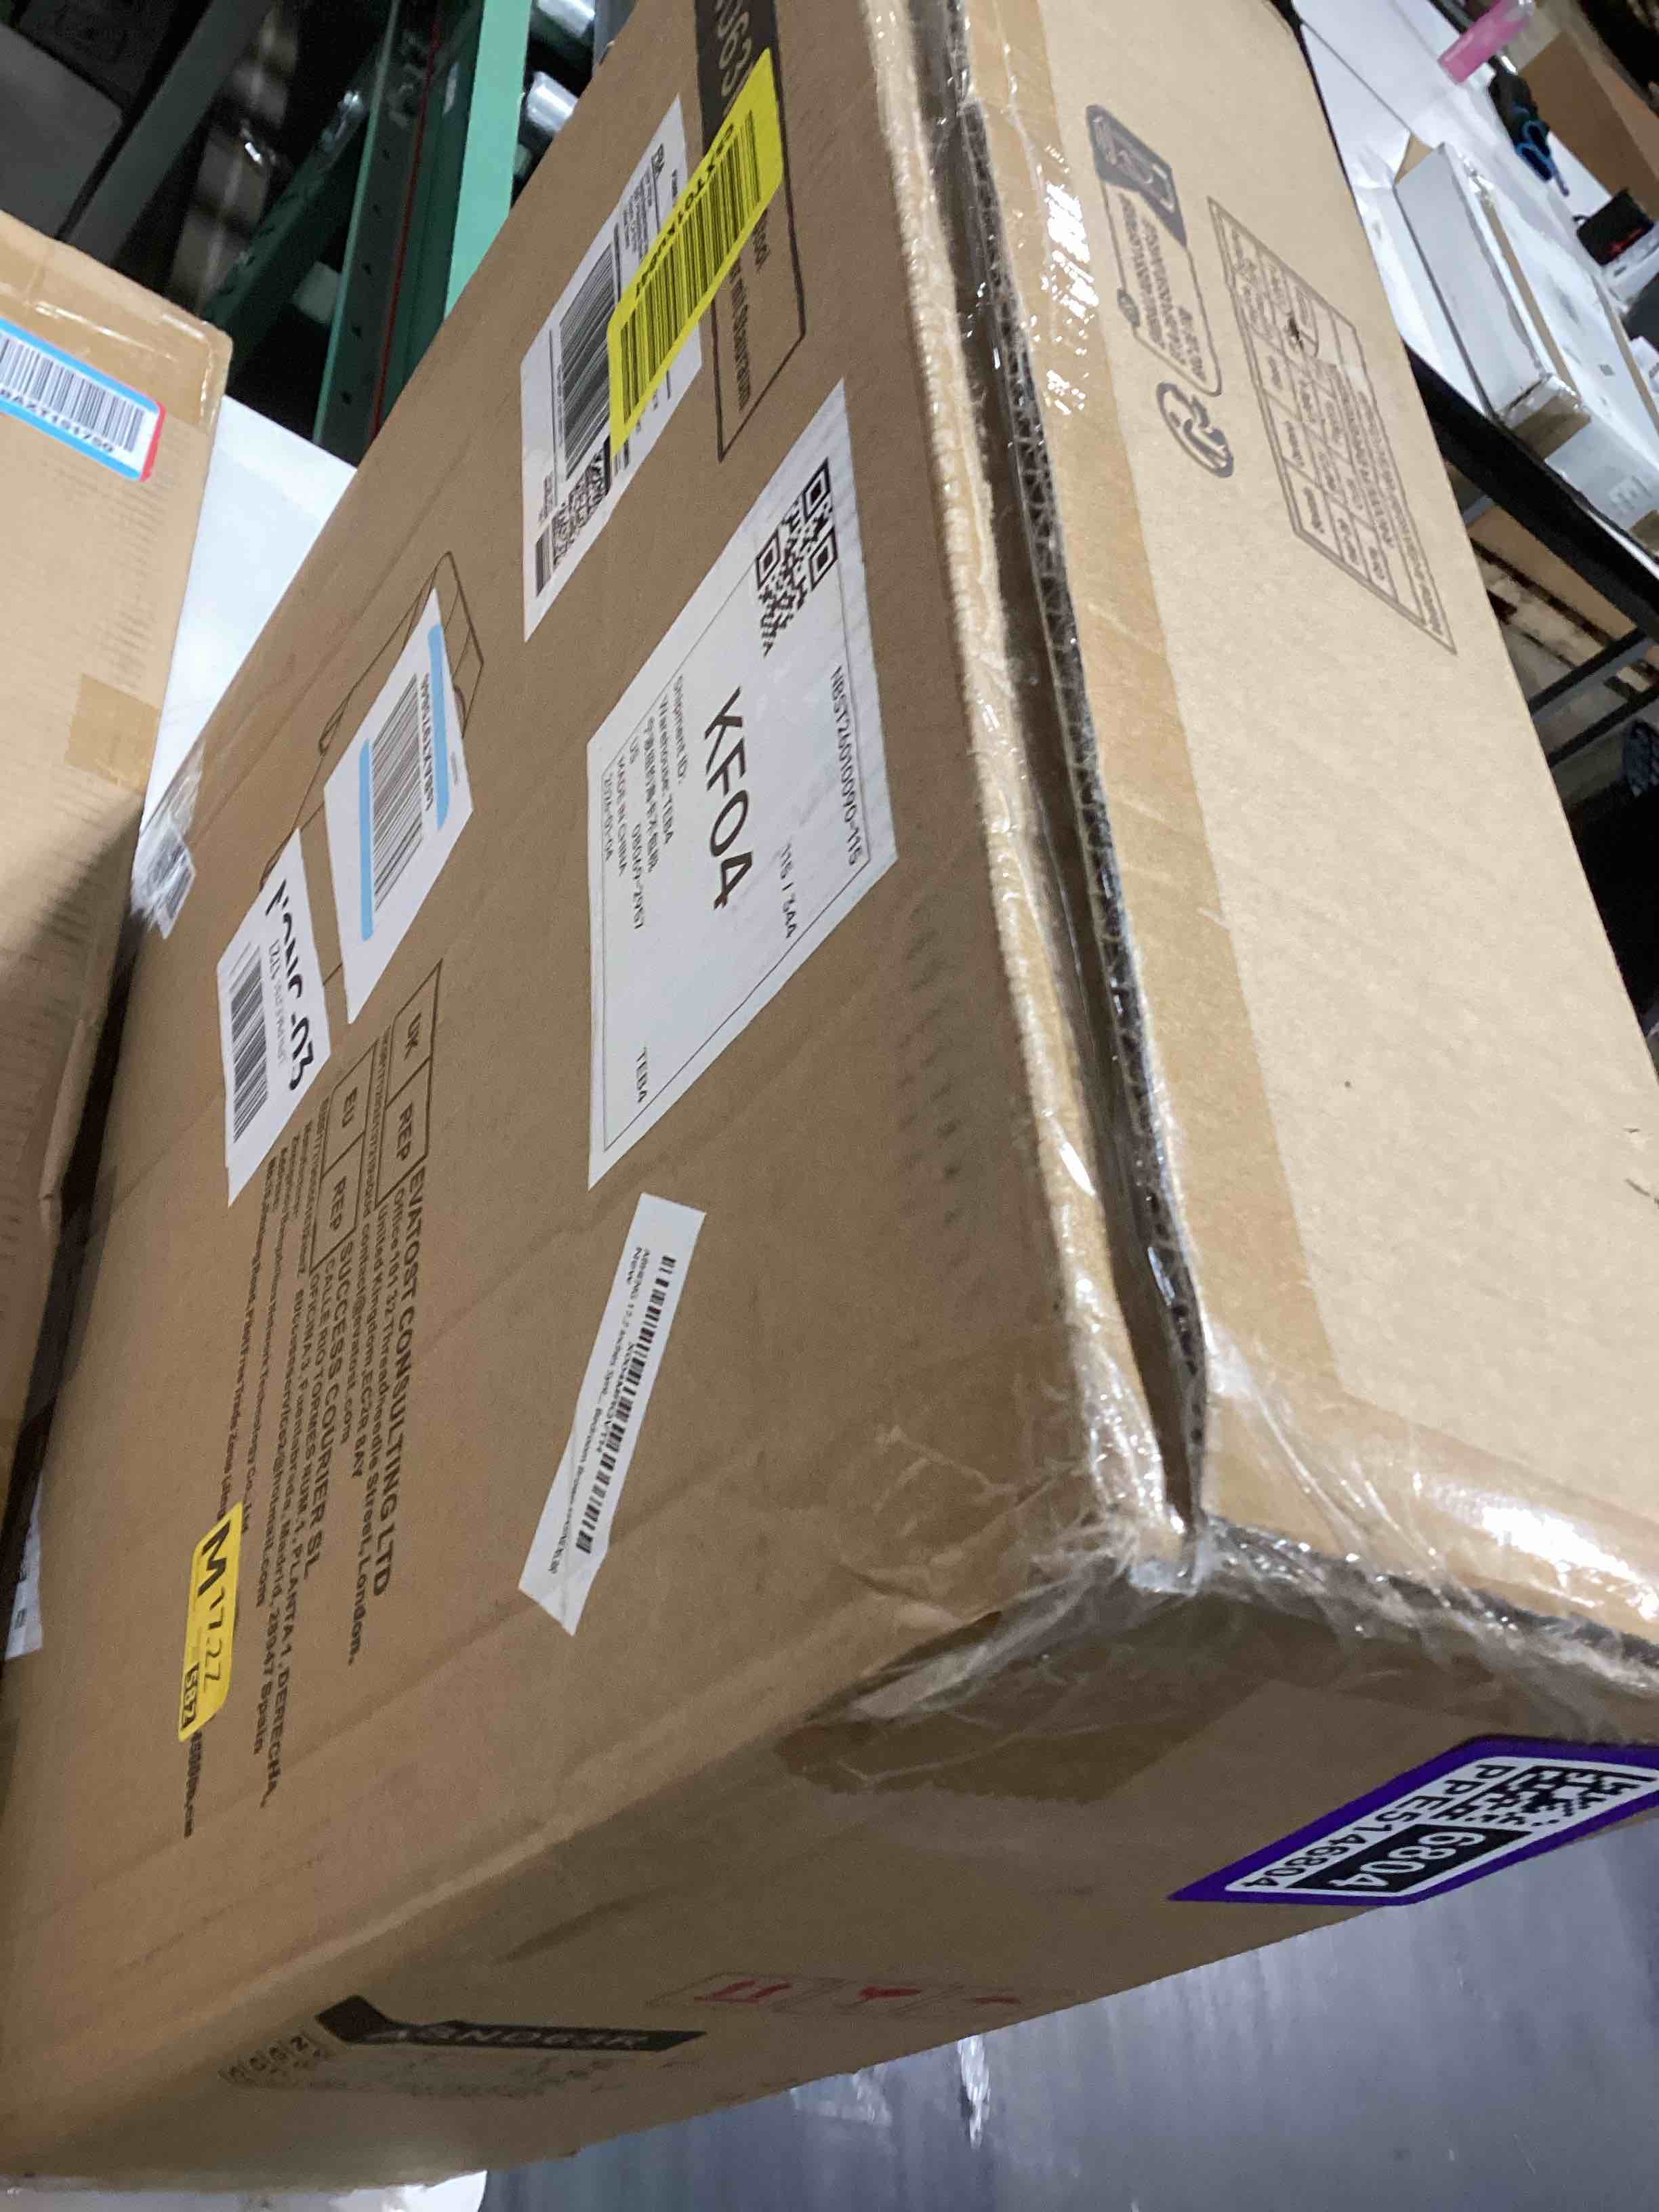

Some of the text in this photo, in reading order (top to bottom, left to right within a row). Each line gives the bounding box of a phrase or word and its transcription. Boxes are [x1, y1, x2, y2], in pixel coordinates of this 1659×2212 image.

[630, 737, 640, 764] US
[662, 793, 674, 845] TEB4
[396, 1012, 422, 1161] UK REP
[636, 1046, 649, 1103] TEB4
[329, 1087, 358, 1231] EU REP
[374, 1204, 388, 1272] United
[302, 1273, 320, 1359] OFICINA
[319, 1258, 335, 1327] CALLE
[304, 1240, 354, 1580] SUCCESS COURIER SL
[306, 1366, 325, 1460] TORMES
[373, 1166, 426, 1597] EVATOST CONSULTING LTD
[197, 1520, 230, 1597] M
[282, 1543, 304, 1643] PLANTA
[253, 1680, 273, 1755] Spain
[1242, 1765, 1517, 1889] PPE5146804
[1329, 1832, 1486, 1886] 6804
